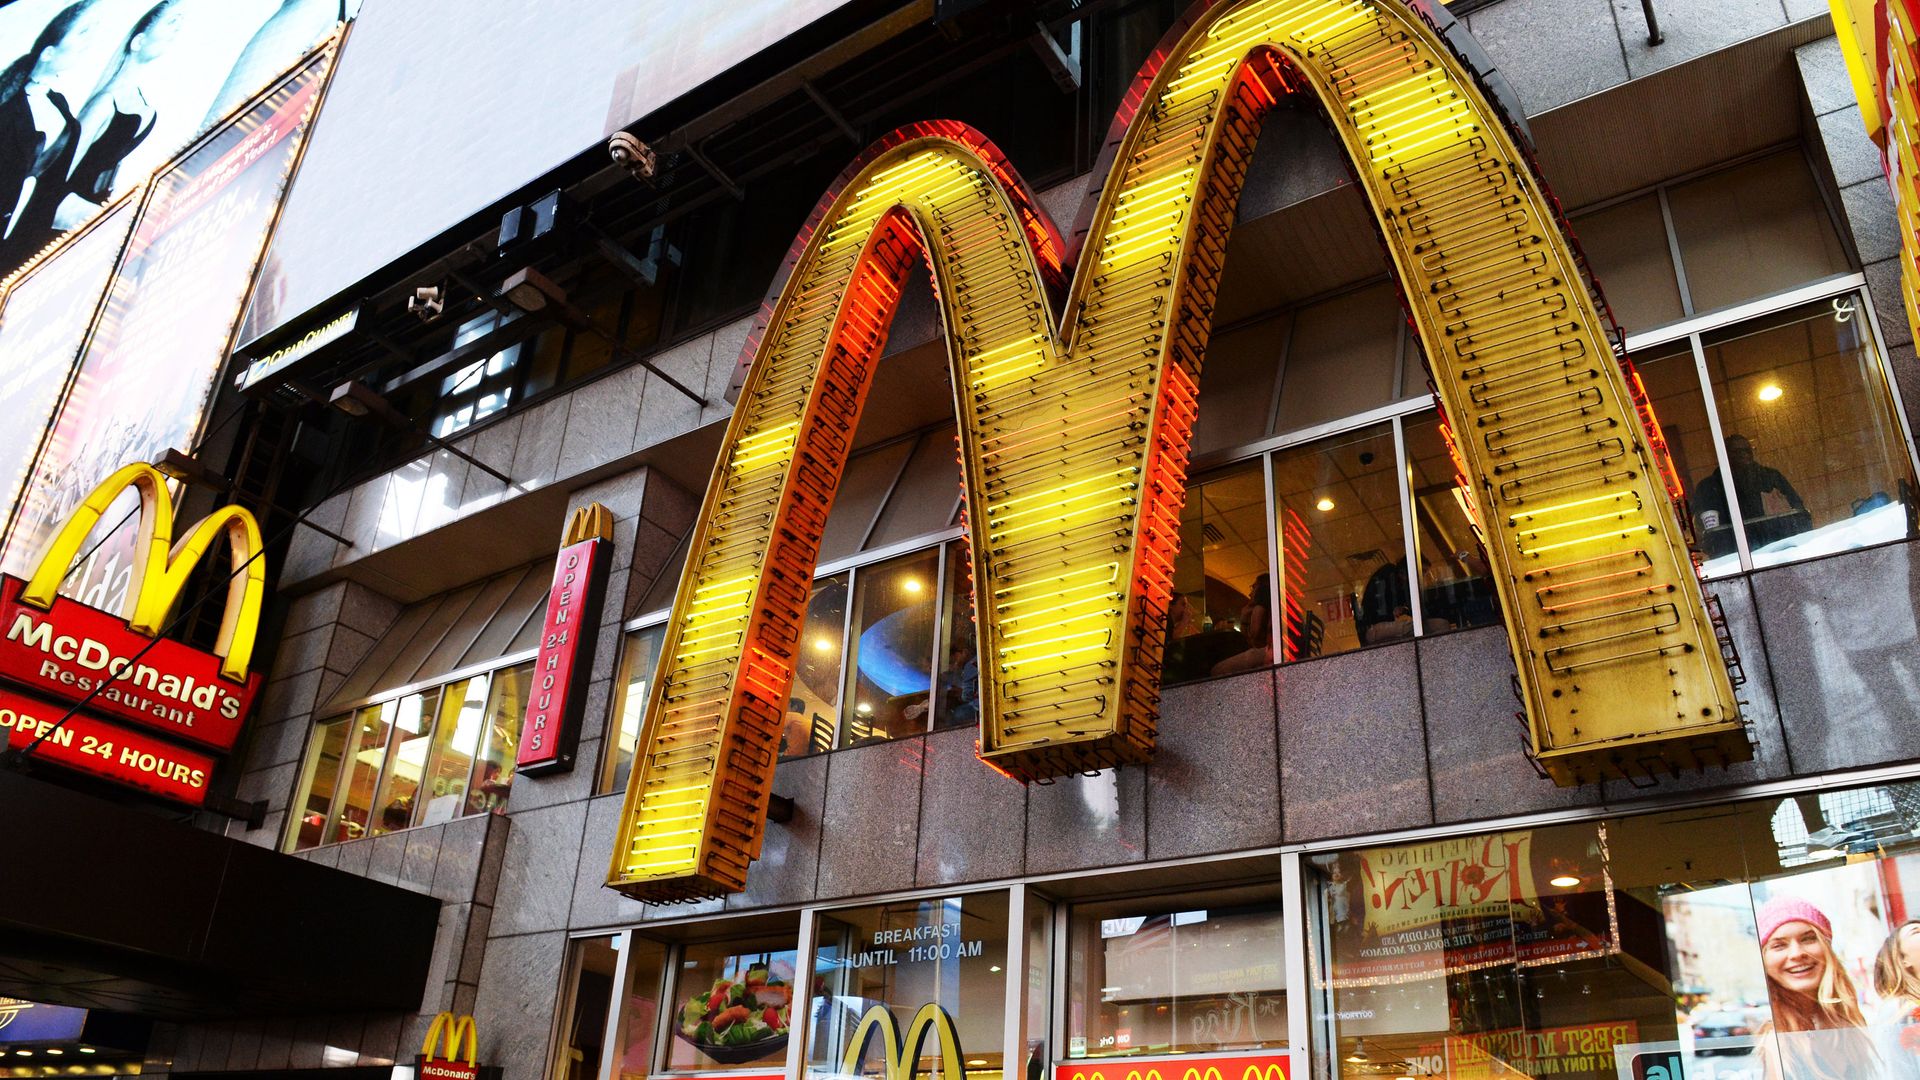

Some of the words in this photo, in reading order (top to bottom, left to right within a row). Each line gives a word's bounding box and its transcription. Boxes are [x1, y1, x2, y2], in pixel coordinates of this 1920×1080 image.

[555, 554, 579, 625] OPEN
[6, 613, 241, 720] McDonald's
[546, 631, 568, 649] 24
[39, 659, 197, 727] Restaurant
[531, 654, 559, 751] HOURS
[0, 708, 75, 748] OPEN
[80, 735, 113, 759] 24
[119, 747, 205, 788] HOURS
[852, 950, 898, 968] UNTIL
[908, 946, 950, 963] 11:00
[956, 940, 982, 958] AM
[874, 922, 960, 945] BREAKFAST
[422, 1066, 476, 1080] McDonald's
